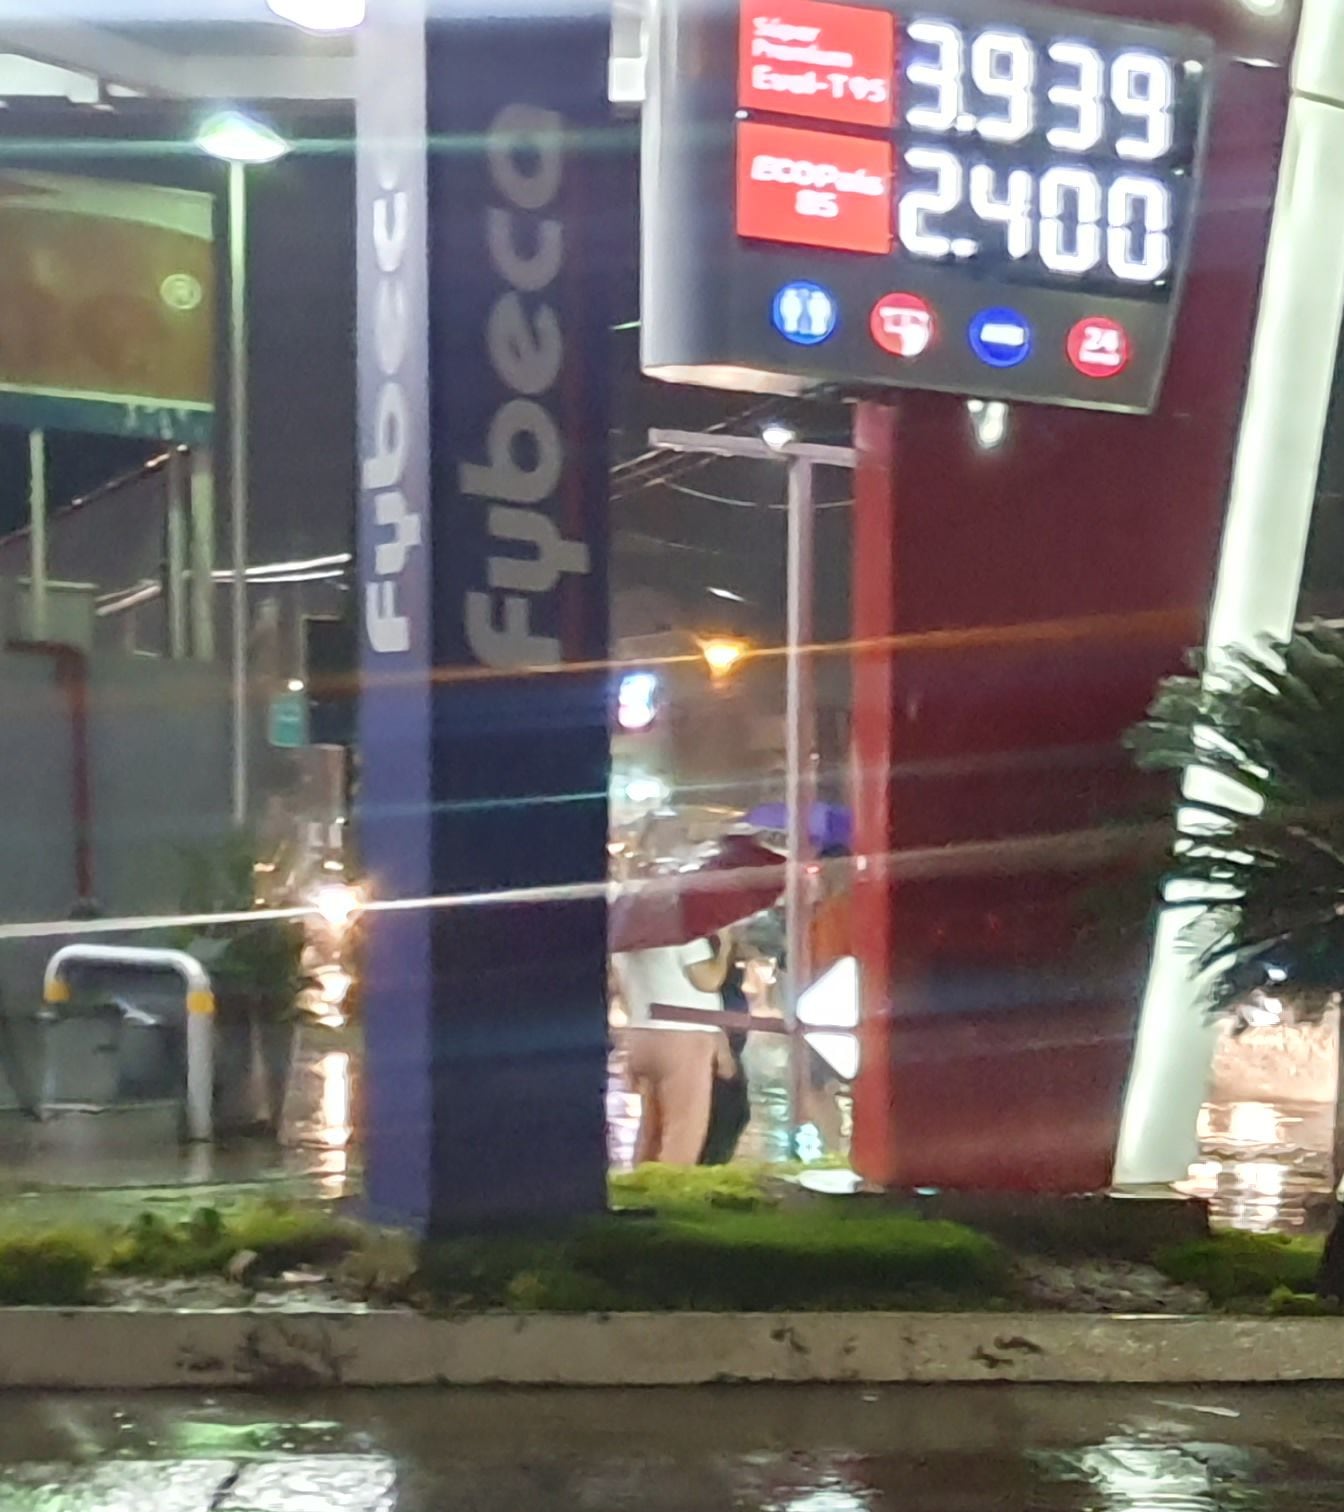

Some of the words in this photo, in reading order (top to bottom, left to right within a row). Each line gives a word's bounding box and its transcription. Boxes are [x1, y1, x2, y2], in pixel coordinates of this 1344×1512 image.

[906, 20, 1174, 160] 3.939
[898, 147, 1170, 281] 2.400
[459, 102, 591, 672] Fybeco
